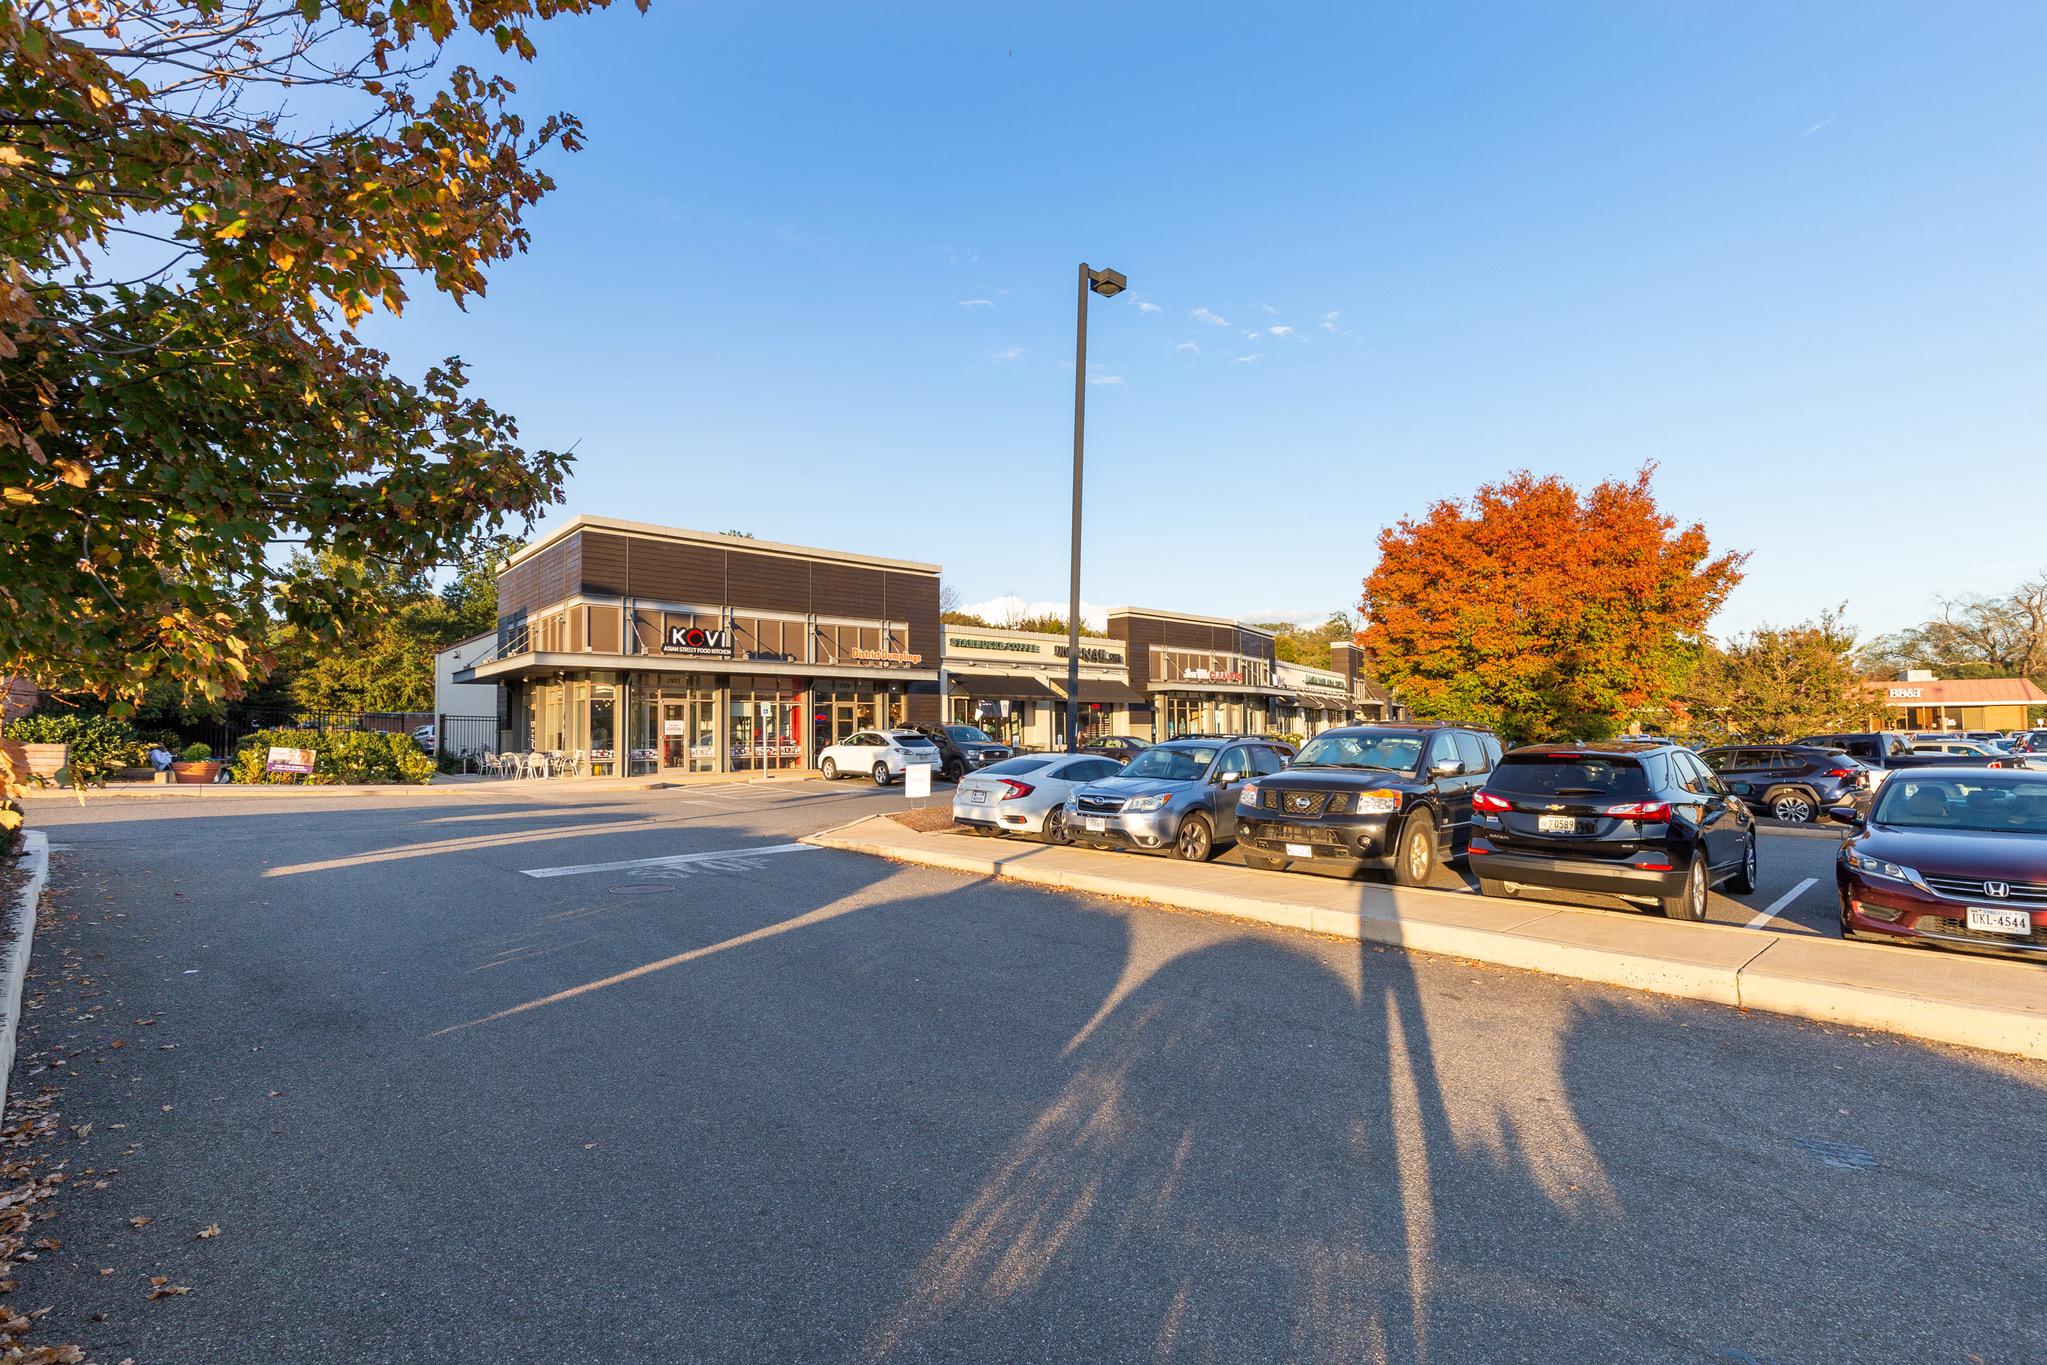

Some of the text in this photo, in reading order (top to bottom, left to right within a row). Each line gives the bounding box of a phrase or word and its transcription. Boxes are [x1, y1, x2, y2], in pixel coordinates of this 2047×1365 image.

[672, 628, 726, 648] KOVI
[949, 638, 1040, 653] STARBUCKS COFFEE
[852, 647, 922, 664] District Dumplings
[1081, 647, 1108, 663] NAIL
[1889, 687, 1921, 698] BB&T
[1554, 819, 1575, 830] 0589
[1972, 912, 2026, 929] UKL-4544
